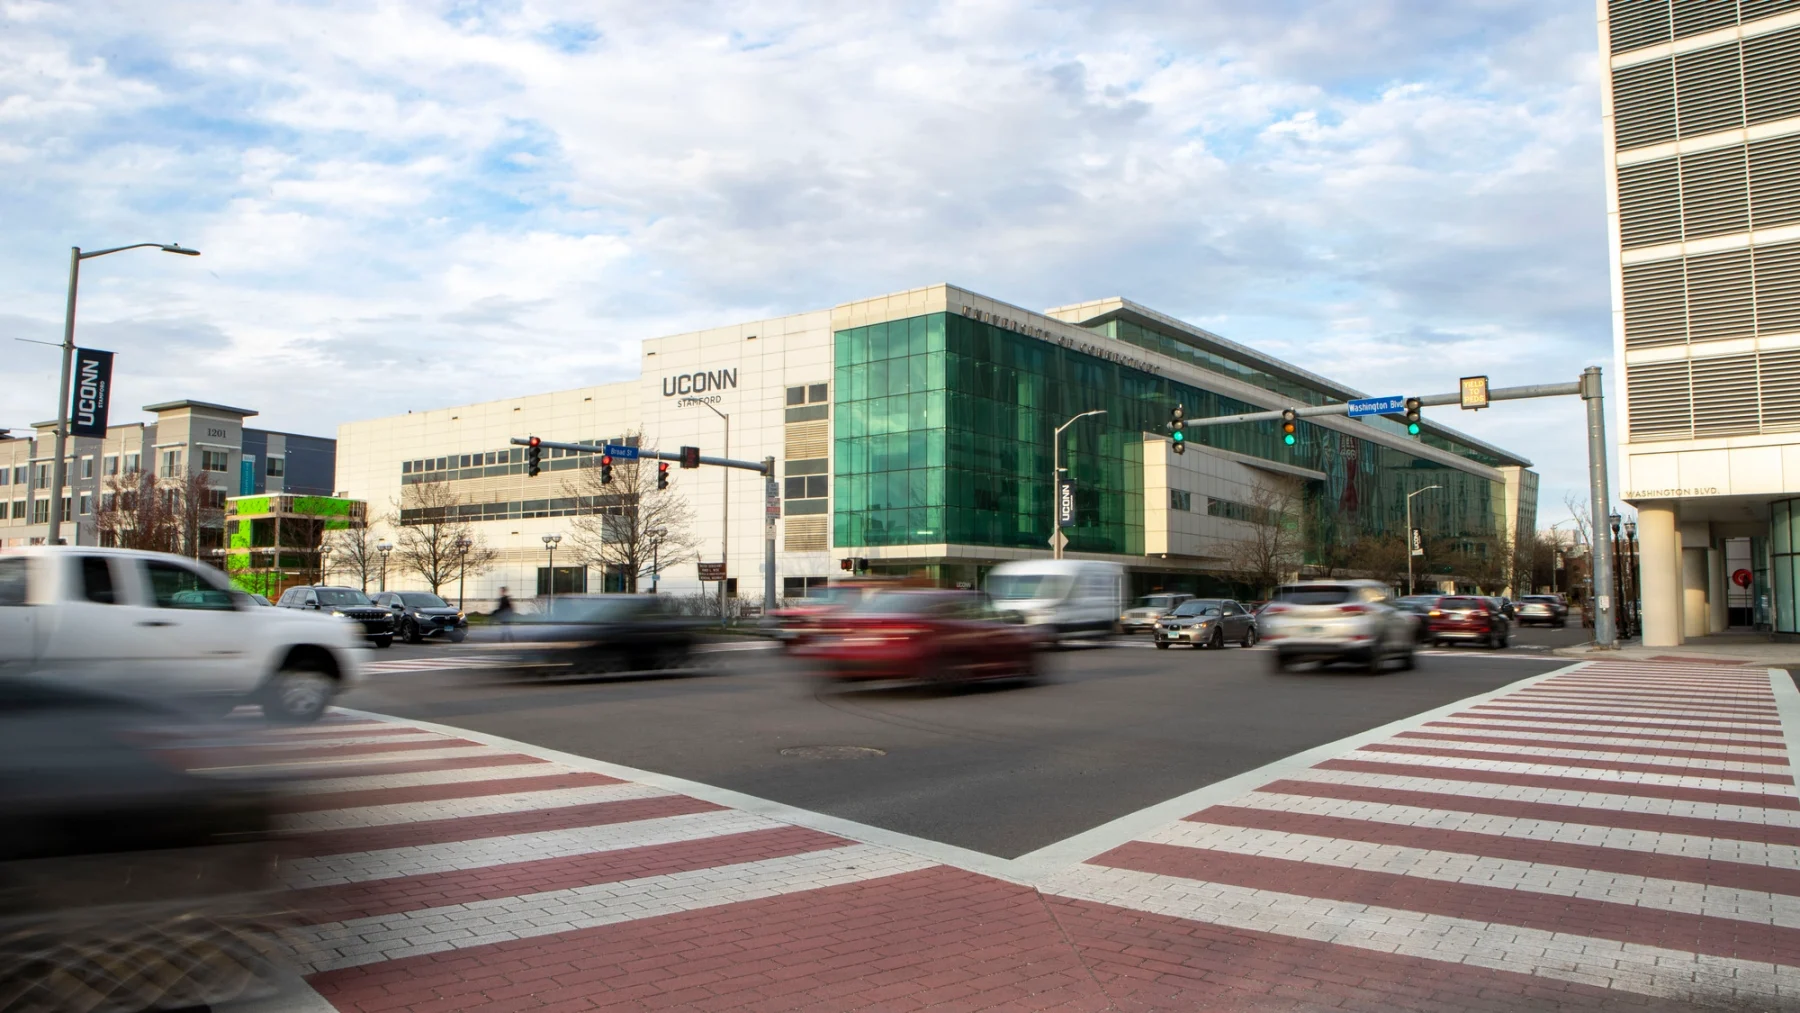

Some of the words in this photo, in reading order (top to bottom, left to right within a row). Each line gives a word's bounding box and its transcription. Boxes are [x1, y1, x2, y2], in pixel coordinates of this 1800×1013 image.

[962, 305, 1051, 341] UNIVERSITY
[663, 367, 737, 397] UCONN
[1463, 380, 1484, 388] YIELD
[78, 359, 100, 426] UCONN
[98, 380, 106, 408] STAMFORD
[1464, 395, 1485, 403] PEDS
[1349, 402, 1388, 412] Washington
[1390, 400, 1403, 409] Blvd
[207, 428, 226, 438] 1201
[1062, 484, 1070, 521] UCONN
[1625, 488, 1691, 498] WASHINGTON
[1694, 487, 1720, 495] BLVD.
